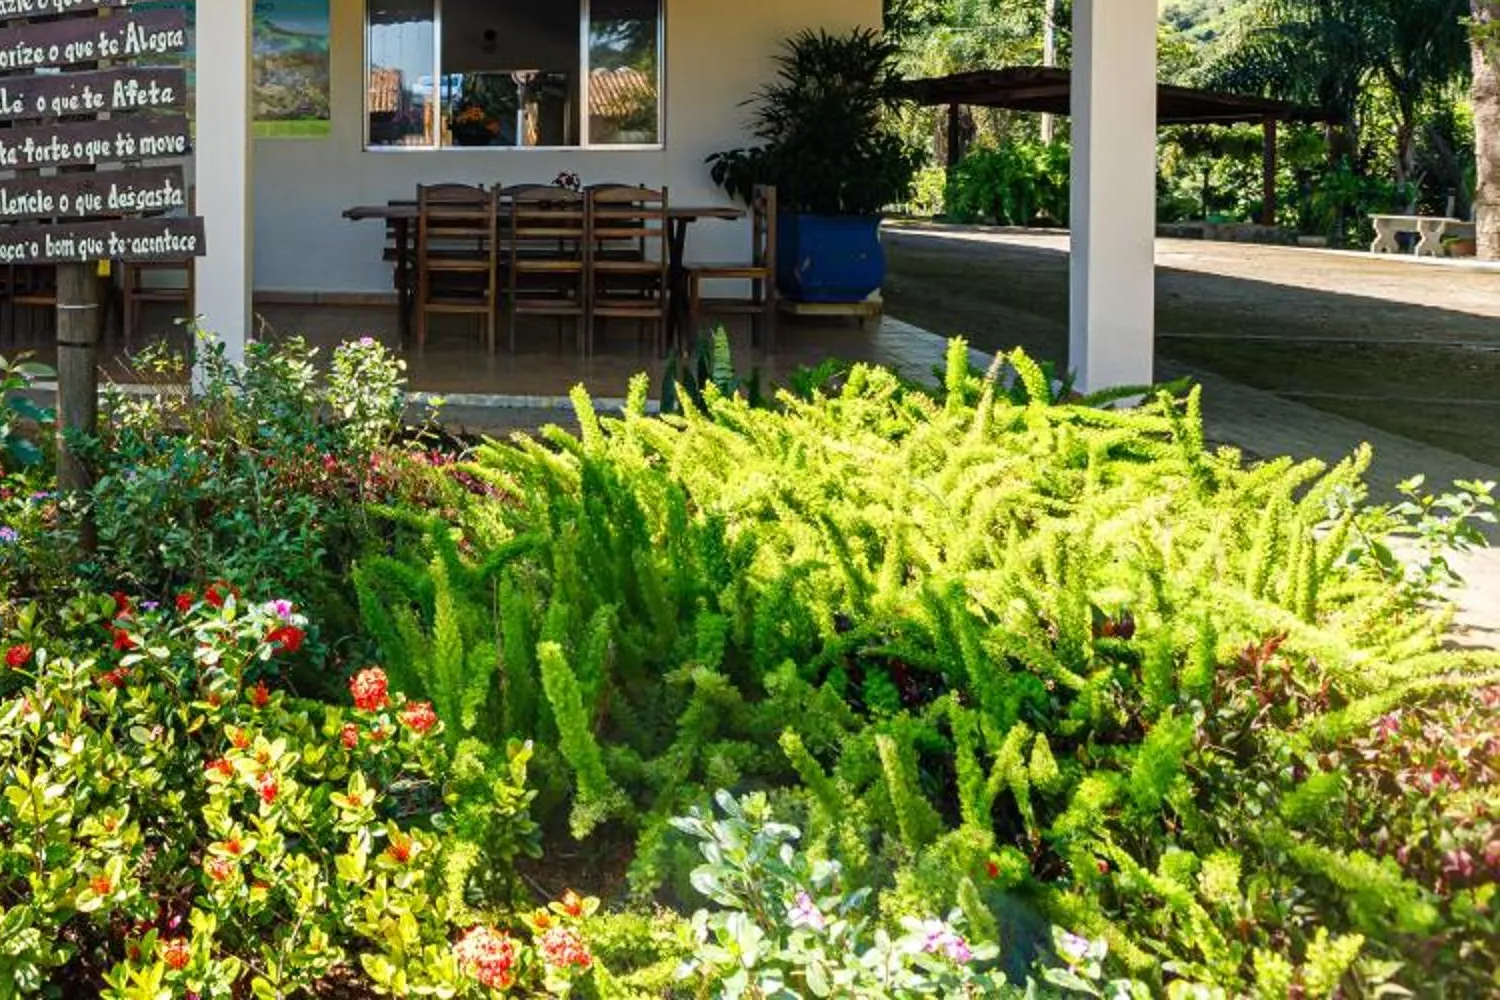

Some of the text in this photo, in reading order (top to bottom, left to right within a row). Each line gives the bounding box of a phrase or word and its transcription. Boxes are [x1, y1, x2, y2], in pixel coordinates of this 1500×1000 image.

[49, 48, 59, 62] o
[65, 40, 93, 64] que
[98, 32, 119, 56] te
[36, 96, 47, 112] o
[51, 92, 77, 116] que
[81, 85, 105, 109] te
[111, 78, 176, 108] Afeta
[22, 136, 70, 162] forte
[73, 144, 83, 159] o
[85, 139, 111, 165] que
[115, 131, 136, 157] te
[139, 134, 186, 154] move
[59, 197, 70, 213] o
[75, 194, 103, 216] que
[107, 178, 185, 210] desgasta
[30, 245, 40, 258] o
[45, 232, 76, 257] bom
[78, 238, 104, 262] que
[108, 231, 126, 254] te
[130, 227, 197, 253] acontece
